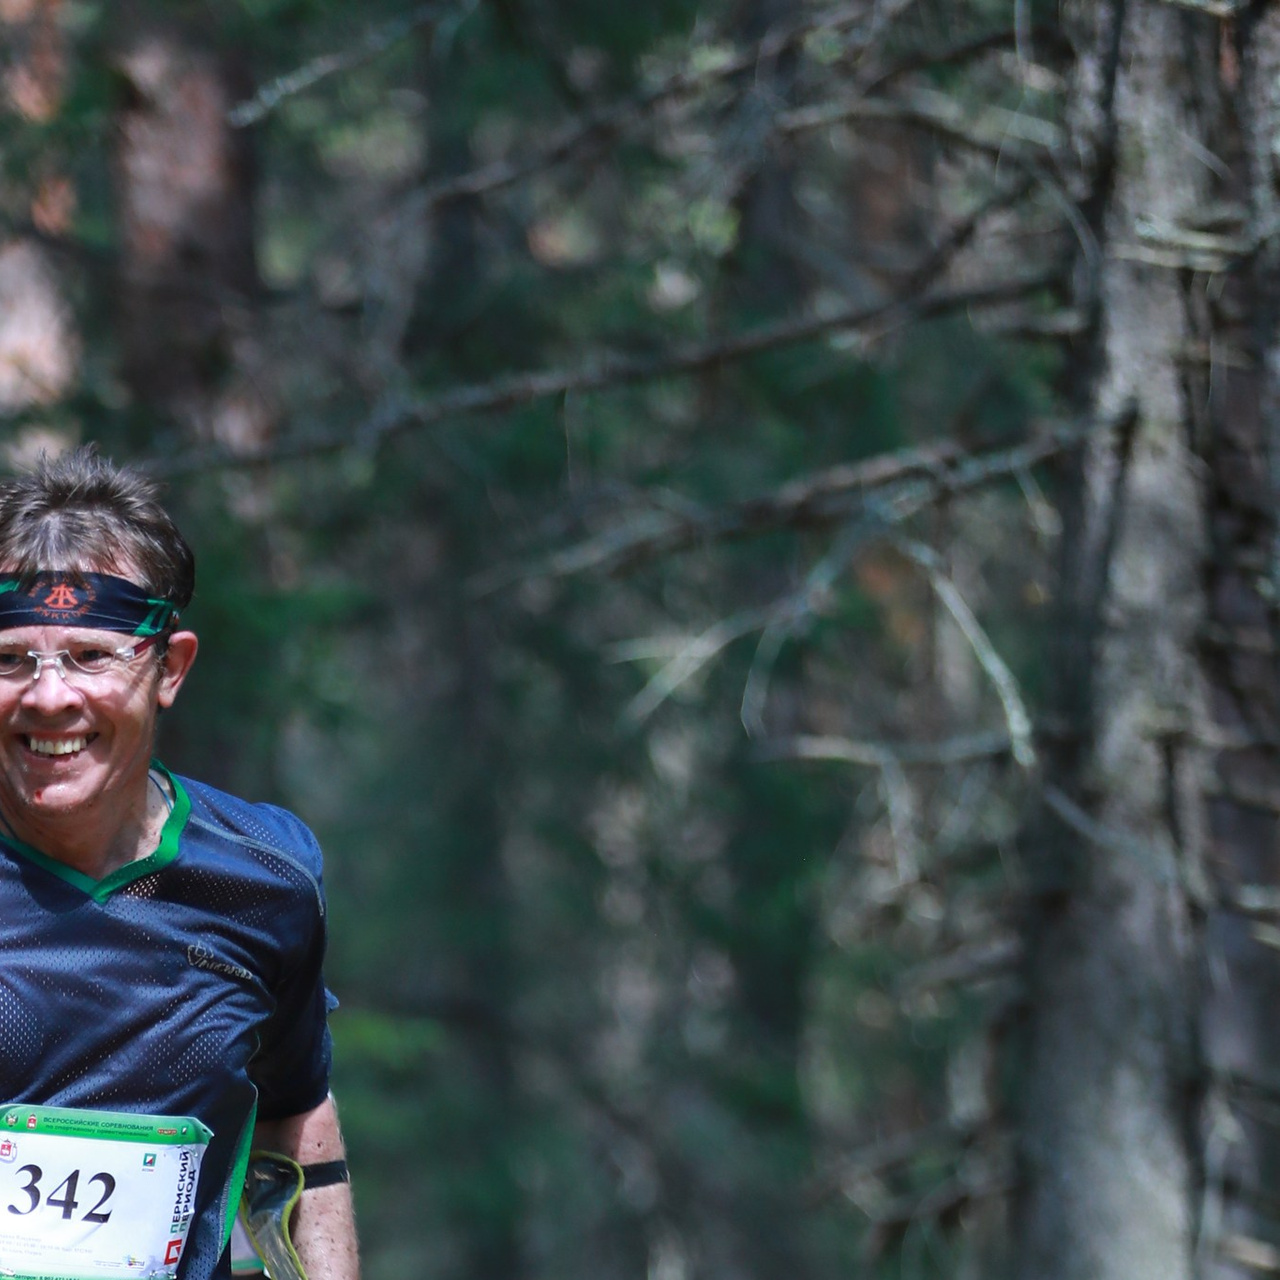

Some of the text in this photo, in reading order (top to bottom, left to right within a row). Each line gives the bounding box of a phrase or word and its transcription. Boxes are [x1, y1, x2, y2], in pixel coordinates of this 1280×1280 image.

[43, 1116, 154, 1131] ВСЕРОССИЙСКИЕ СОРЕВНОВАНИЯ
[7, 1164, 116, 1224] 342
[170, 1151, 189, 1233] ПЕРМСКИЙ
[179, 1169, 196, 1232] ПЕРИОД
